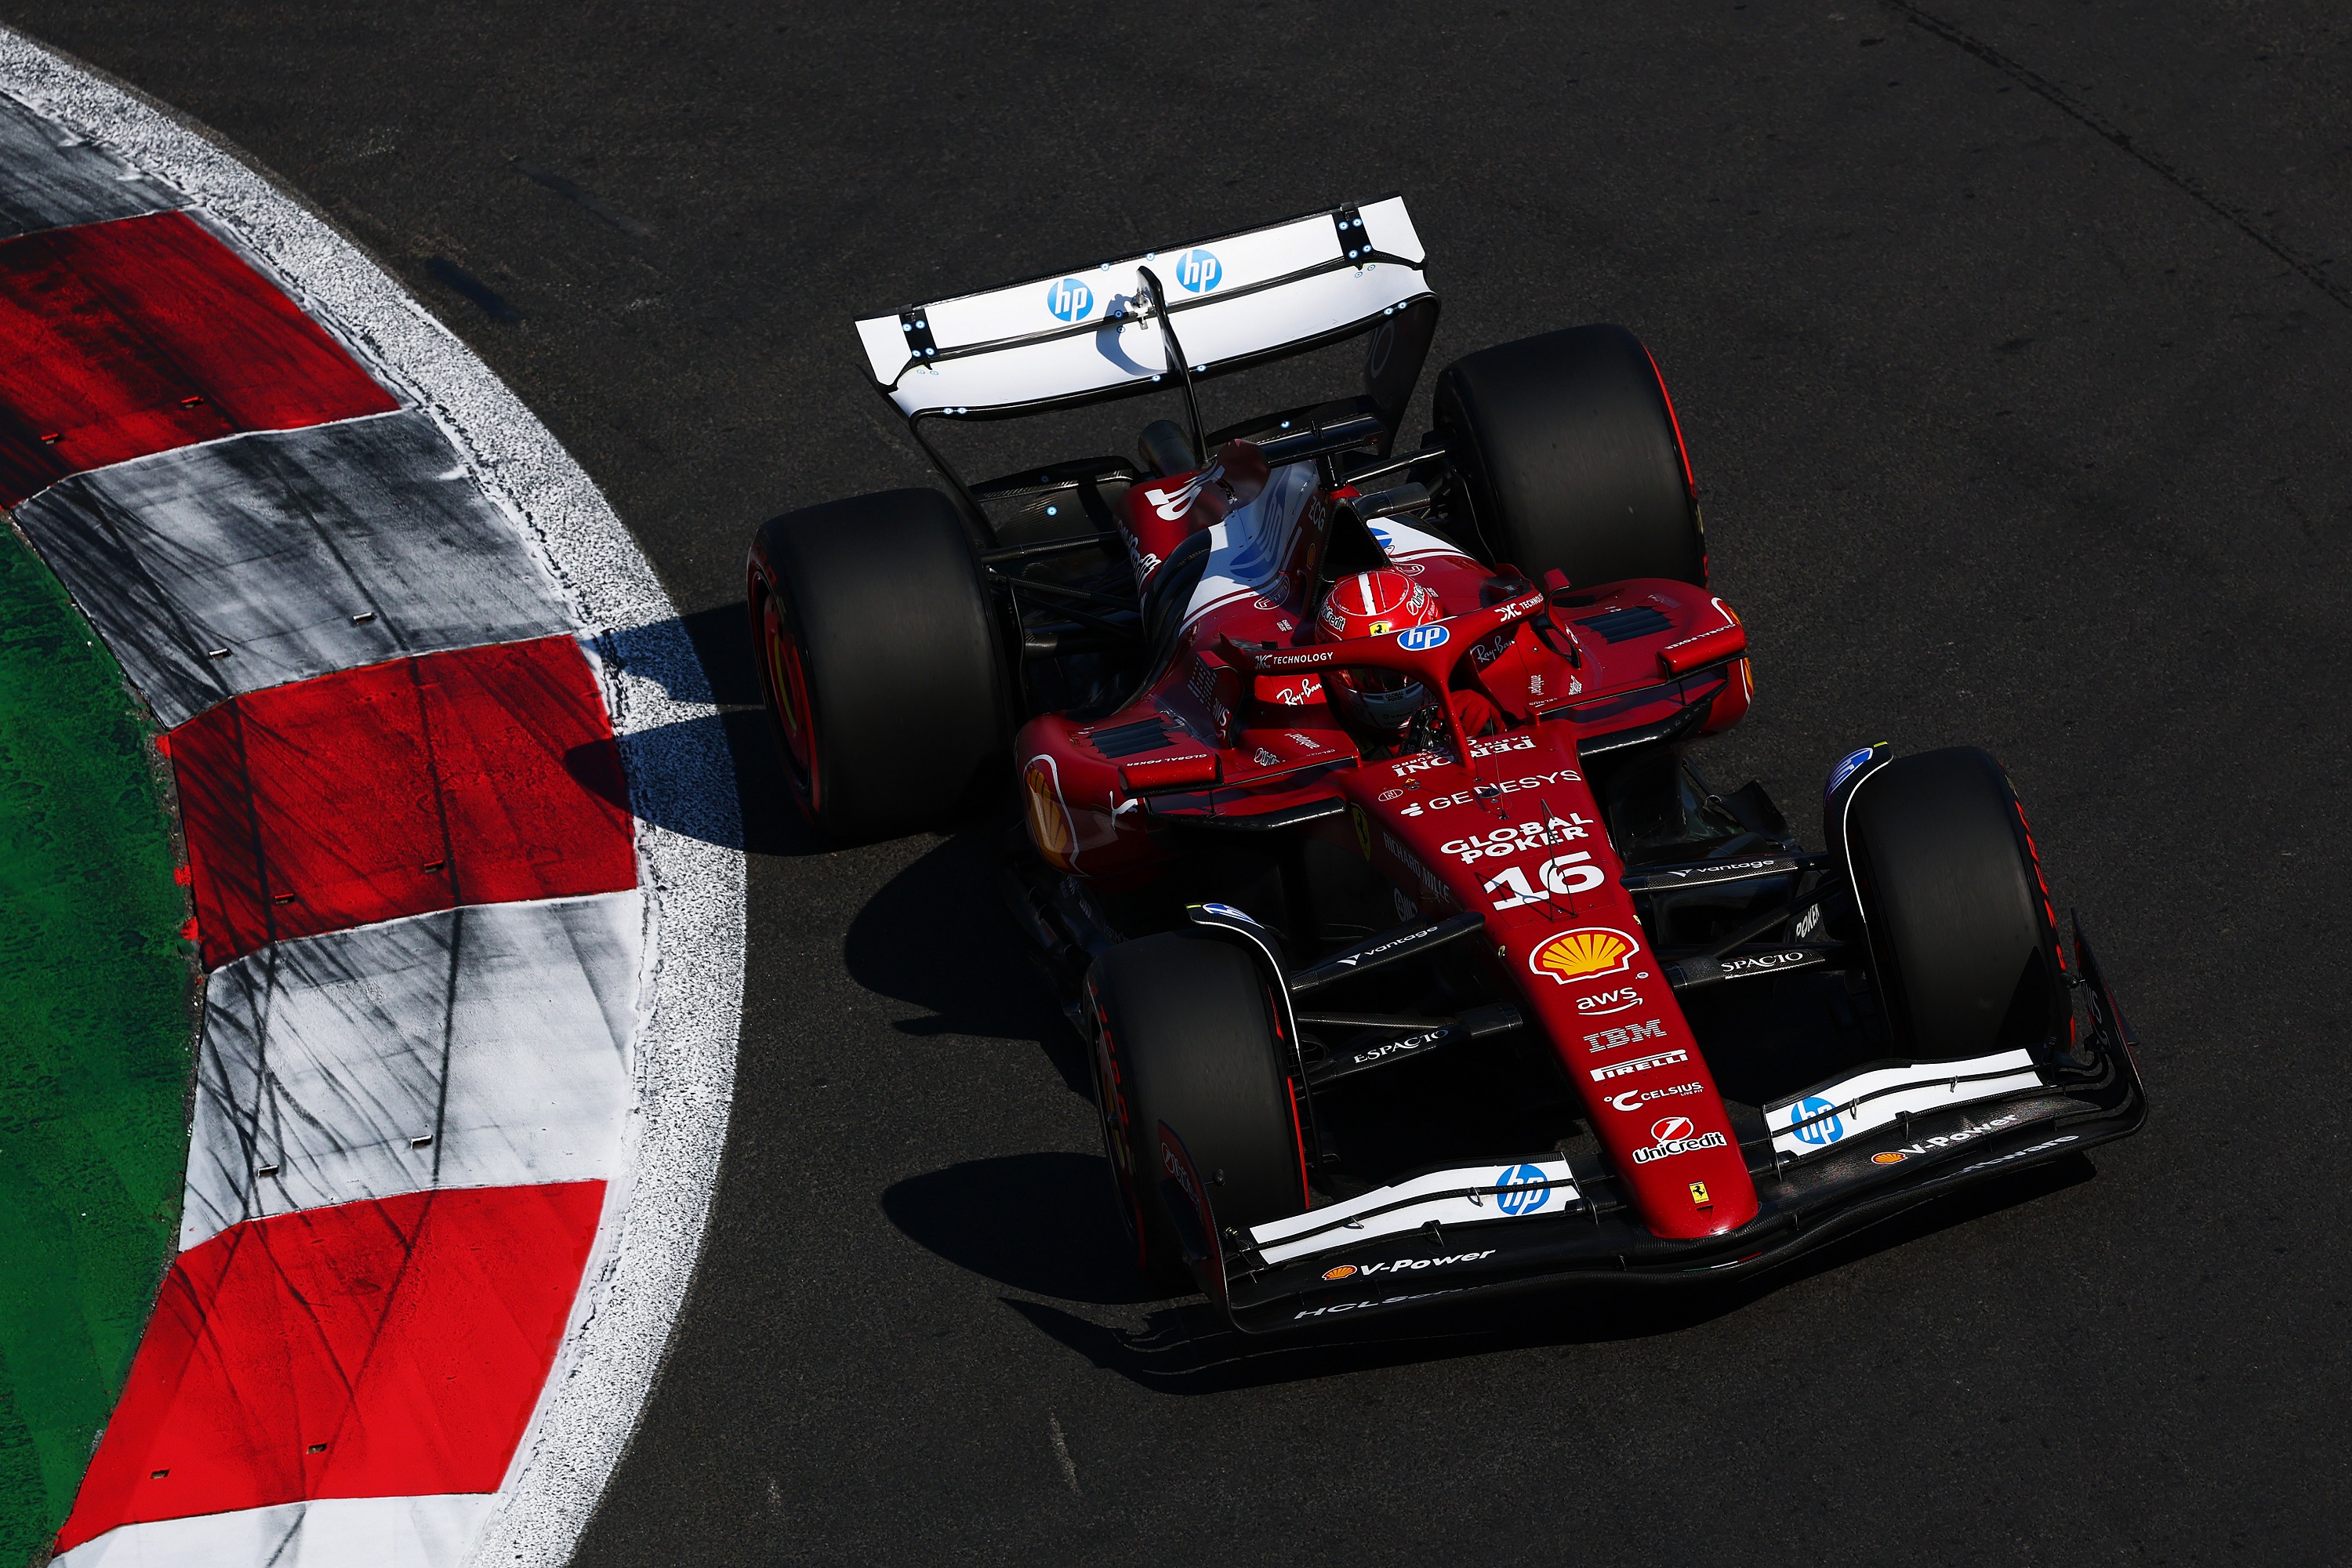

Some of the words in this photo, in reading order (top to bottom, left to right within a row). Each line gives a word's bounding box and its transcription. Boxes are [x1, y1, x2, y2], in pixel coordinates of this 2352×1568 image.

[1182, 249, 1216, 292] hp
[1054, 279, 1088, 321] hp
[1406, 627, 1441, 649] hp
[1470, 635, 1515, 663] Ray-Ban
[1273, 652, 1334, 665] TECHNOLOGY
[1276, 678, 1323, 707] Ray-Ban
[1164, 753, 1207, 762] GLOBAL
[1428, 769, 1581, 810] GENESYS
[1440, 813, 1594, 855] GLOBAL
[1461, 826, 1589, 865] POKER
[1382, 831, 1421, 878] RICHARD
[1422, 866, 1450, 903] MILLE
[1483, 851, 1605, 911] 16
[1697, 860, 1774, 873] vantage
[1795, 903, 1820, 939] POKER
[1364, 926, 1439, 956] vantage
[1576, 986, 1638, 1010] aws
[1583, 1019, 1668, 1054] IBM
[1590, 1049, 1689, 1082] PIRELLI
[1640, 1082, 1701, 1101] CELSIUS
[1796, 1100, 1835, 1145] hp
[1898, 1114, 2018, 1156] V-Power
[1633, 1132, 1727, 1163] UniCredit
[1502, 1164, 1544, 1215] hp
[1360, 1249, 1497, 1276] V-Power
